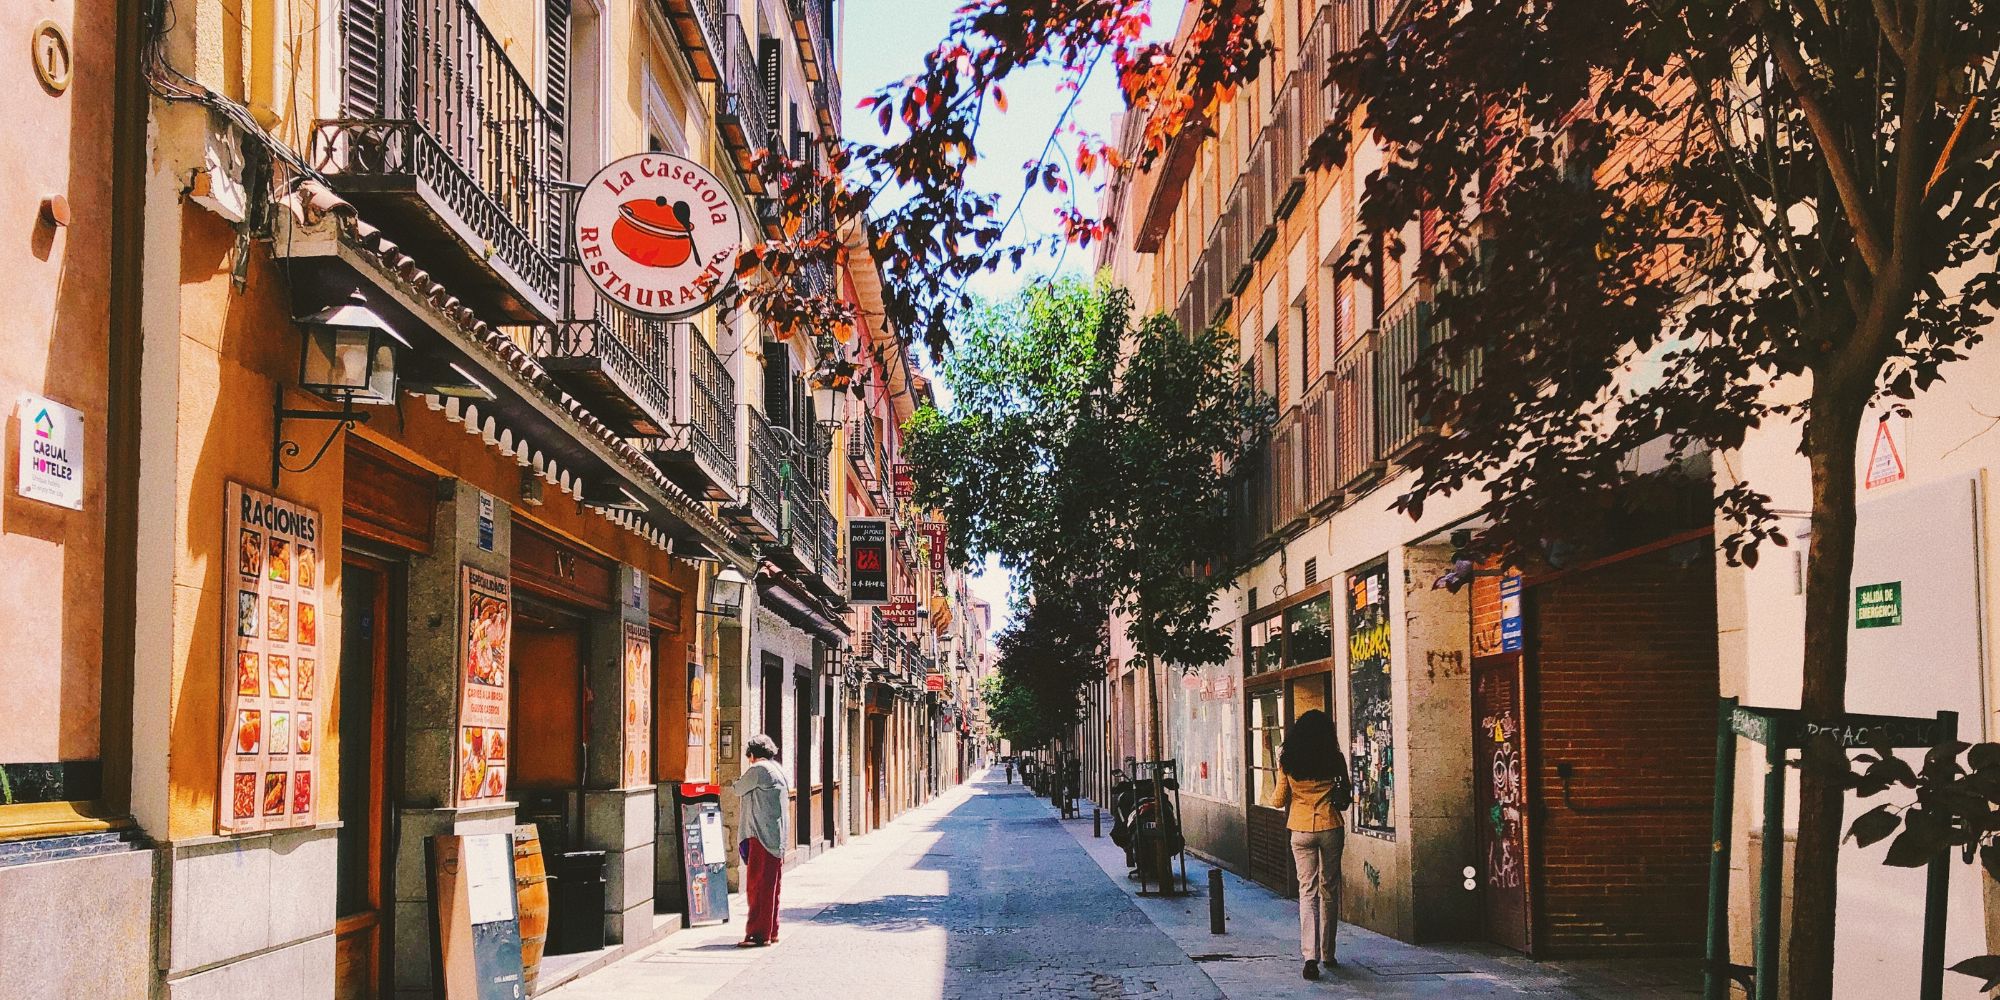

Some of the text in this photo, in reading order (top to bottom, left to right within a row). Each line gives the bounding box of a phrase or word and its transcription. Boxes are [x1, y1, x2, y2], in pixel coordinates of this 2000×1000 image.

[603, 158, 728, 225] La Caserola
[33, 440, 68, 463] CASUAL
[32, 457, 72, 481] HOTELES
[241, 493, 315, 543] RACIONES
[1861, 588, 1894, 605] SALIDA DE
[1858, 603, 1898, 620] EMERGENCIA
